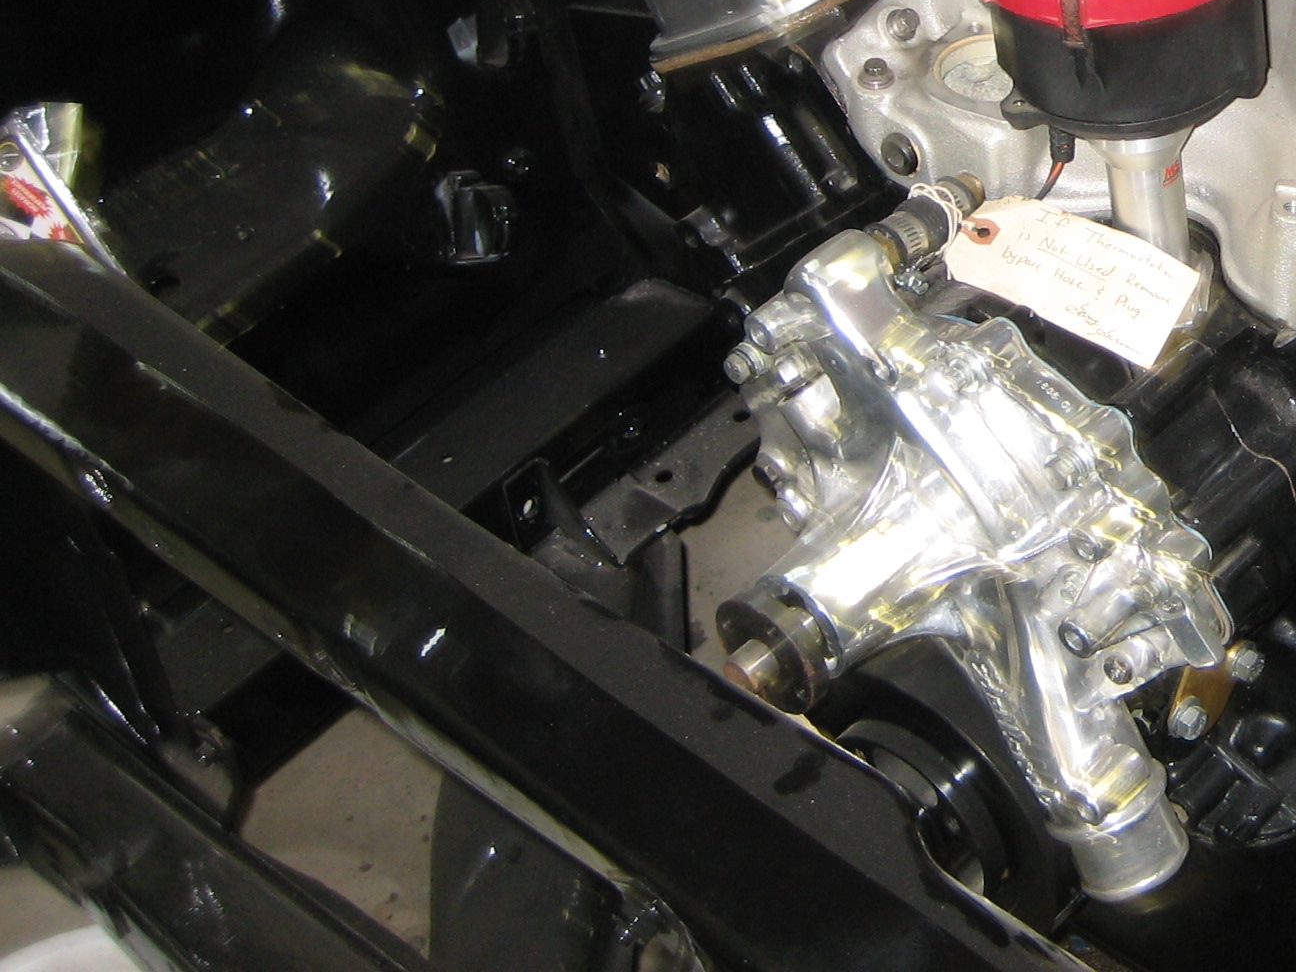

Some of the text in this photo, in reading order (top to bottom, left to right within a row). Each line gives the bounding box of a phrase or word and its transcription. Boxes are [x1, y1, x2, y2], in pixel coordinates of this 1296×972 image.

[1035, 208, 1070, 228] If
[1018, 227, 1171, 305] is Not Used Remove
[1053, 267, 1087, 291] Hose
